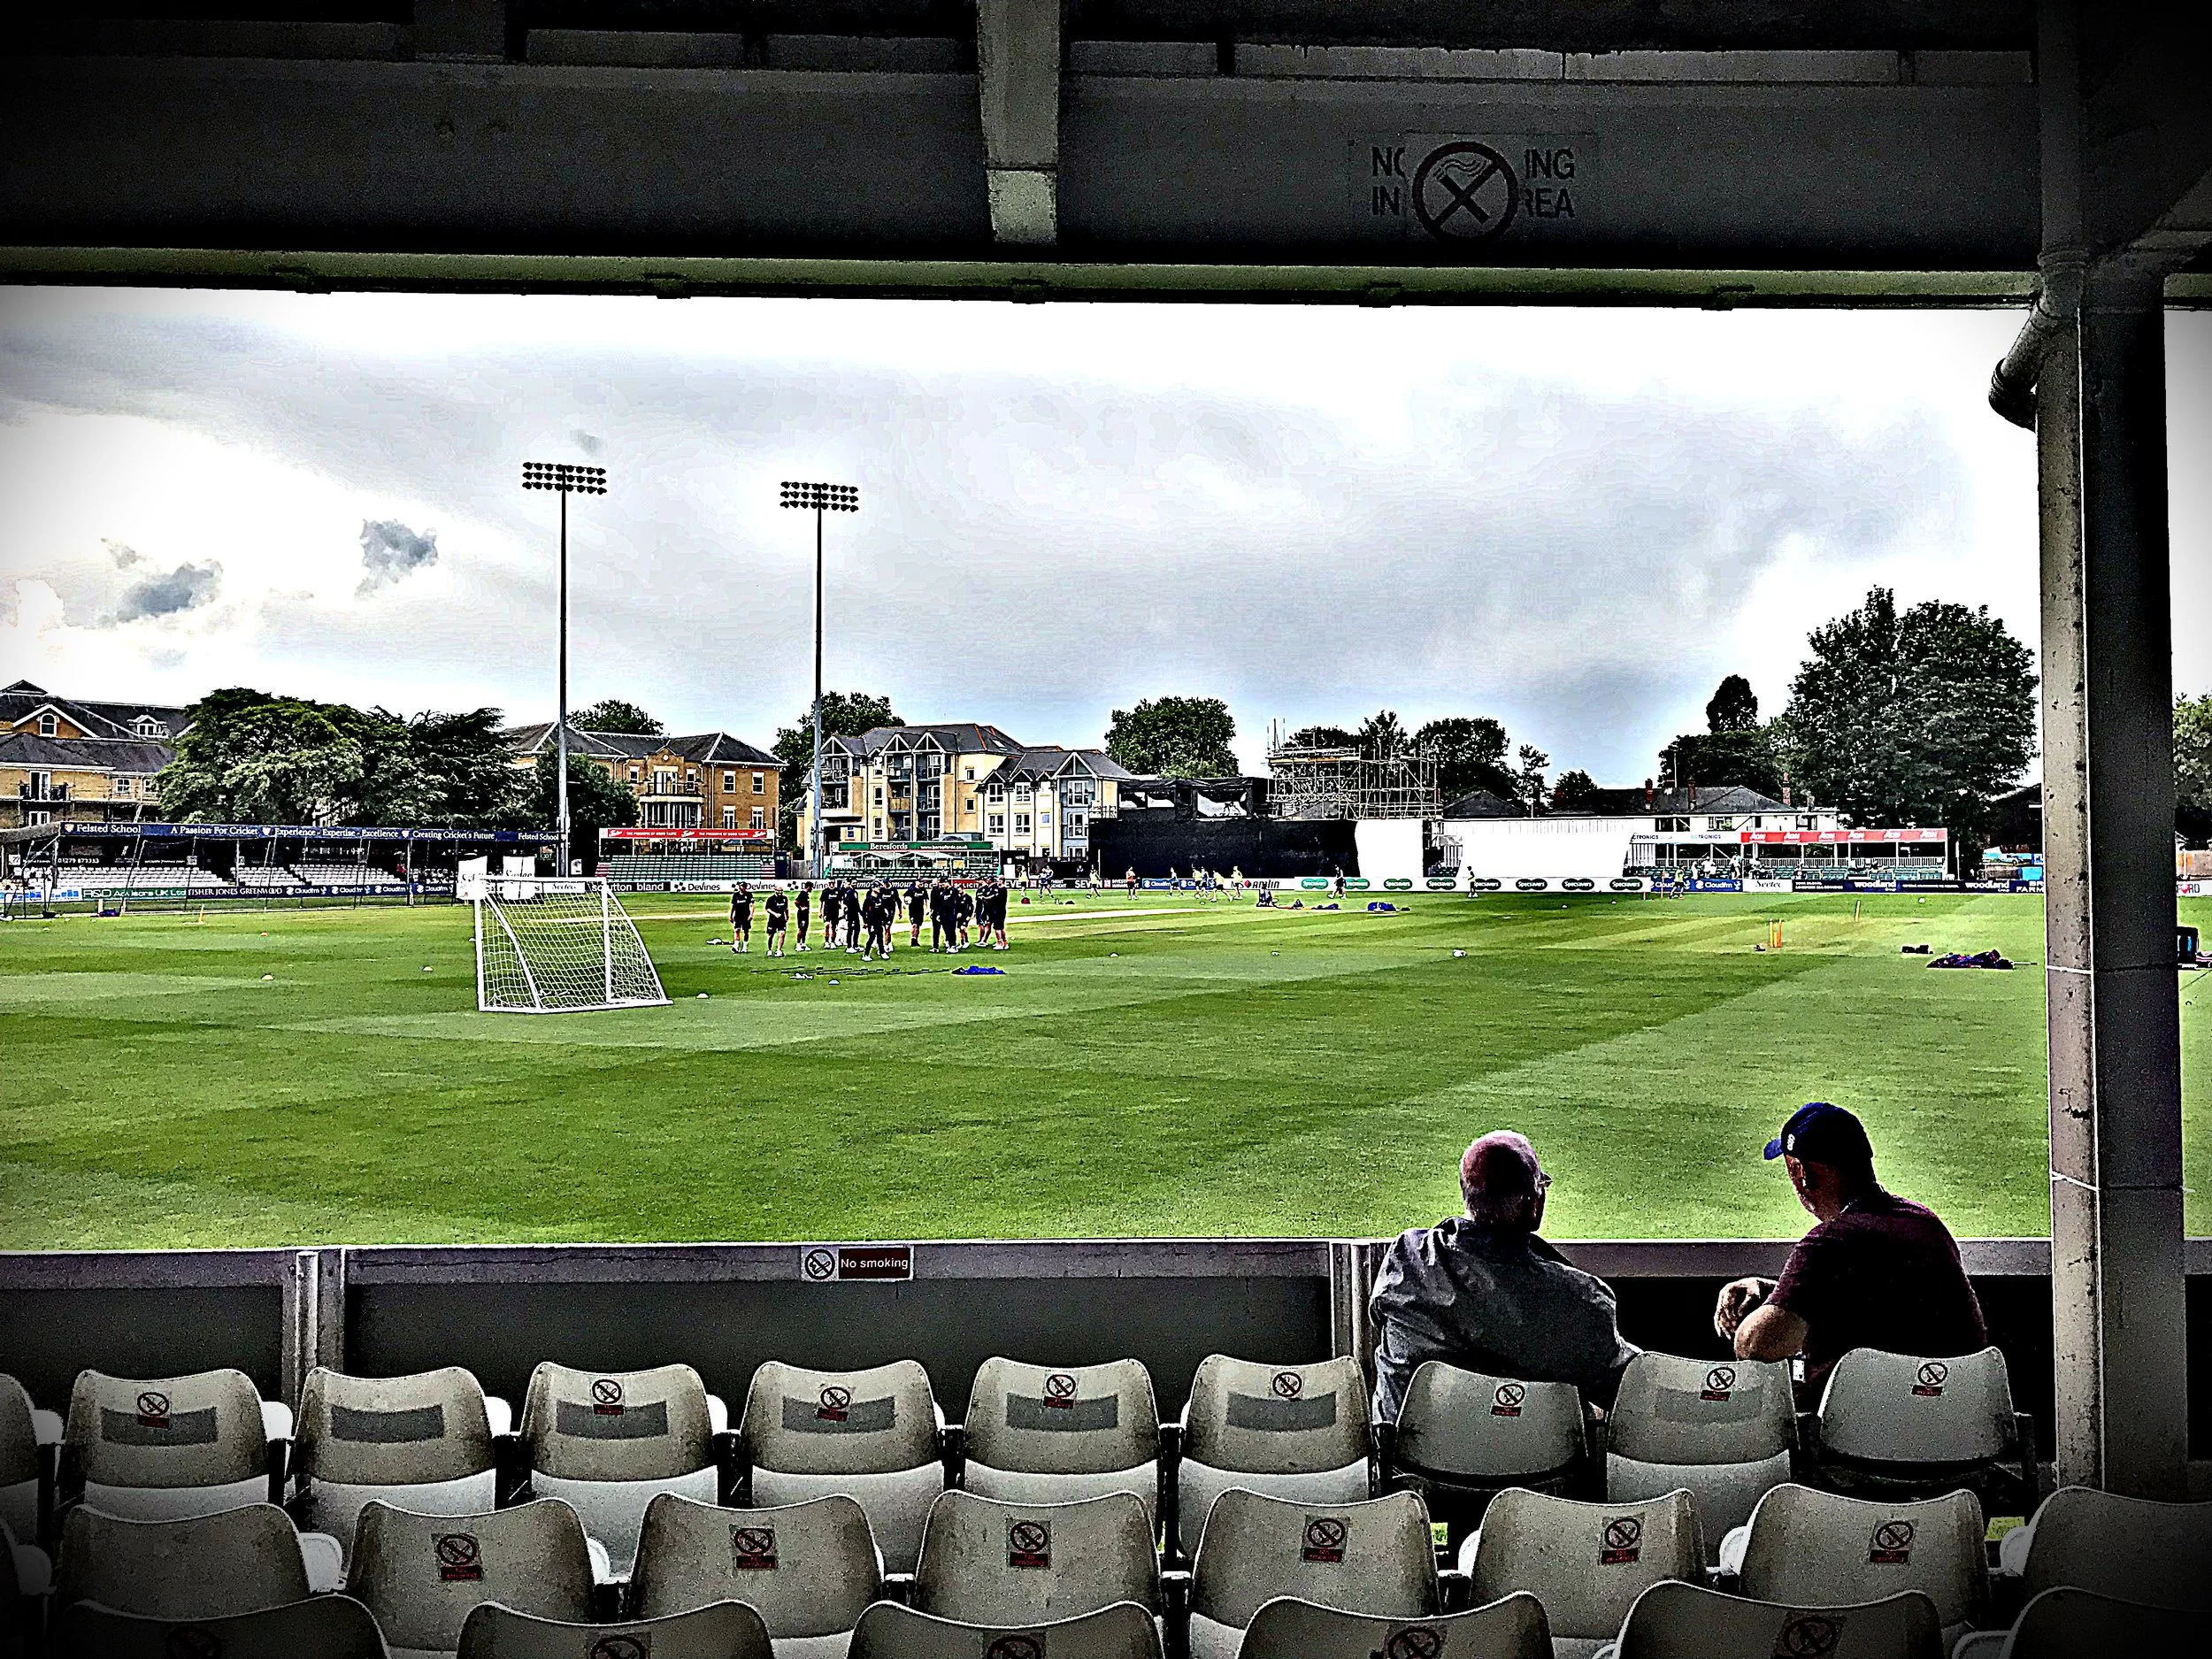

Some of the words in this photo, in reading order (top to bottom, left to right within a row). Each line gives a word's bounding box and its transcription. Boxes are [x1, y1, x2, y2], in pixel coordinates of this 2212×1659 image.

[77, 824, 109, 833] Felsted
[111, 825, 142, 833] School
[171, 826, 178, 834] A
[229, 826, 258, 835] Cricket
[275, 828, 316, 837] Experience
[322, 828, 356, 838] Expertise
[362, 829, 399, 838] Excellence
[412, 830, 442, 840] Creating
[473, 831, 495, 840] Future
[518, 832, 539, 841] Felsted
[636, 882, 664, 891] bland
[688, 882, 720, 891] DeVines
[1075, 879, 1103, 889] SEVN
[1855, 879, 1897, 888] woodland
[1965, 879, 2010, 889] woodland
[841, 1259, 856, 1268] No
[860, 1258, 909, 1270] smoking
